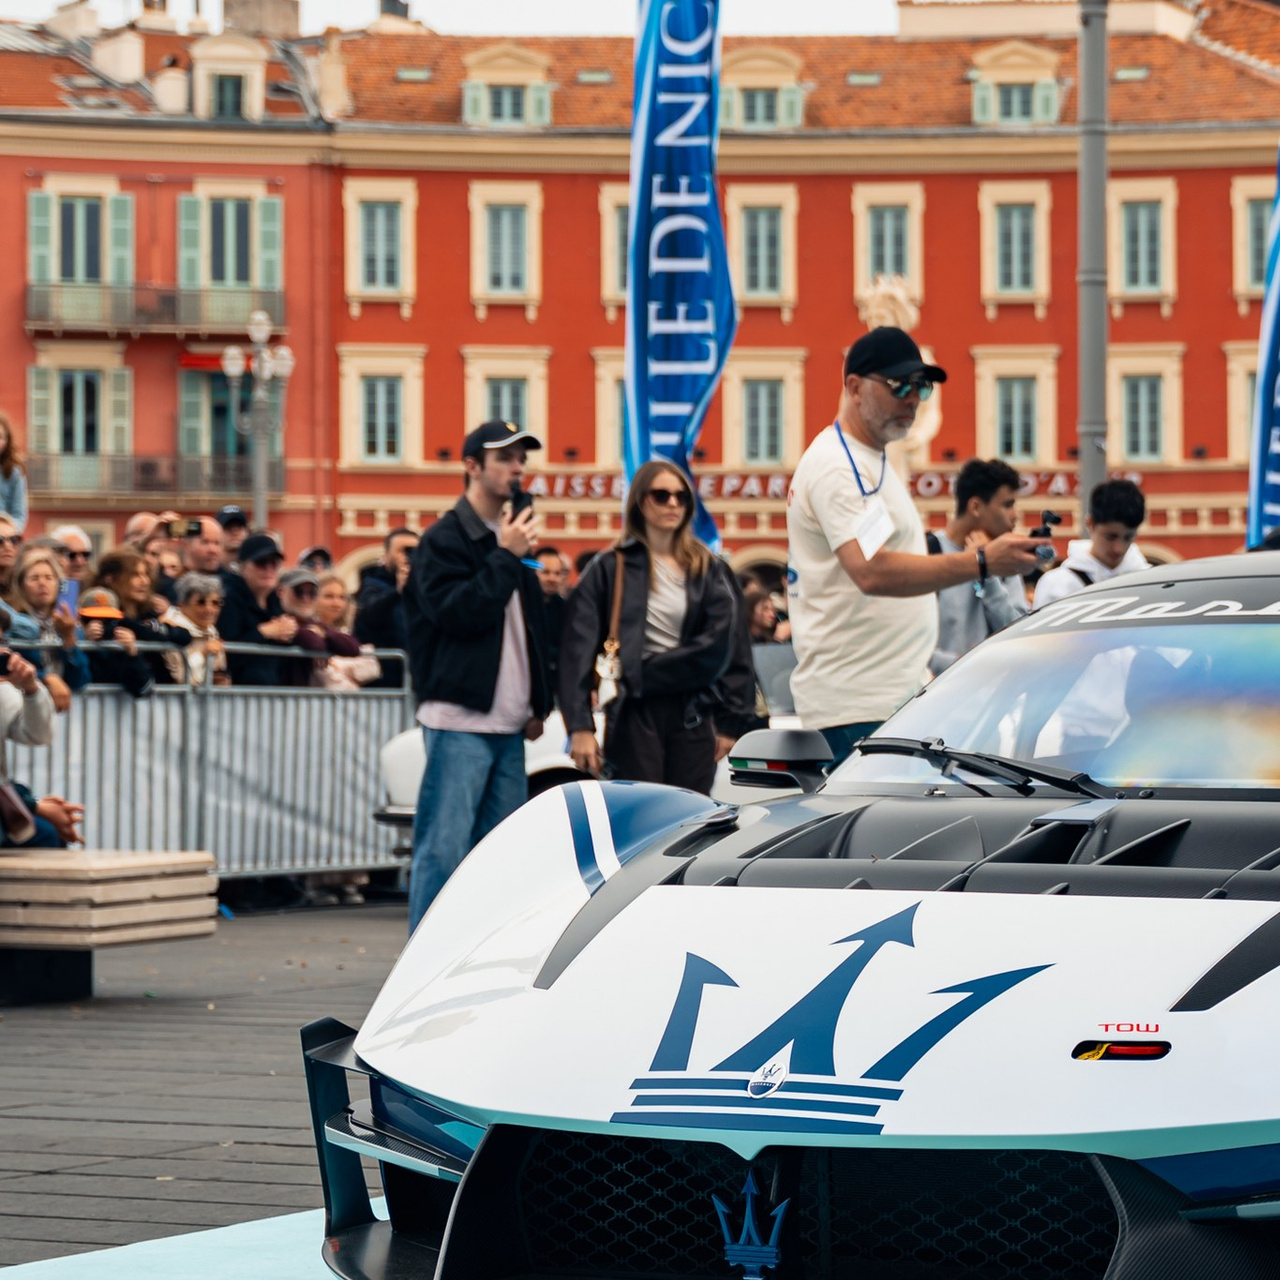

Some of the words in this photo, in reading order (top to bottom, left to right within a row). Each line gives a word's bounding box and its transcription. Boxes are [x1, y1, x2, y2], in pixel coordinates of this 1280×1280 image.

[649, 174, 711, 277] DE
[527, 474, 623, 498] AISSE
[699, 474, 786, 498] EPAR
[1098, 1023, 1159, 1033] TOW
